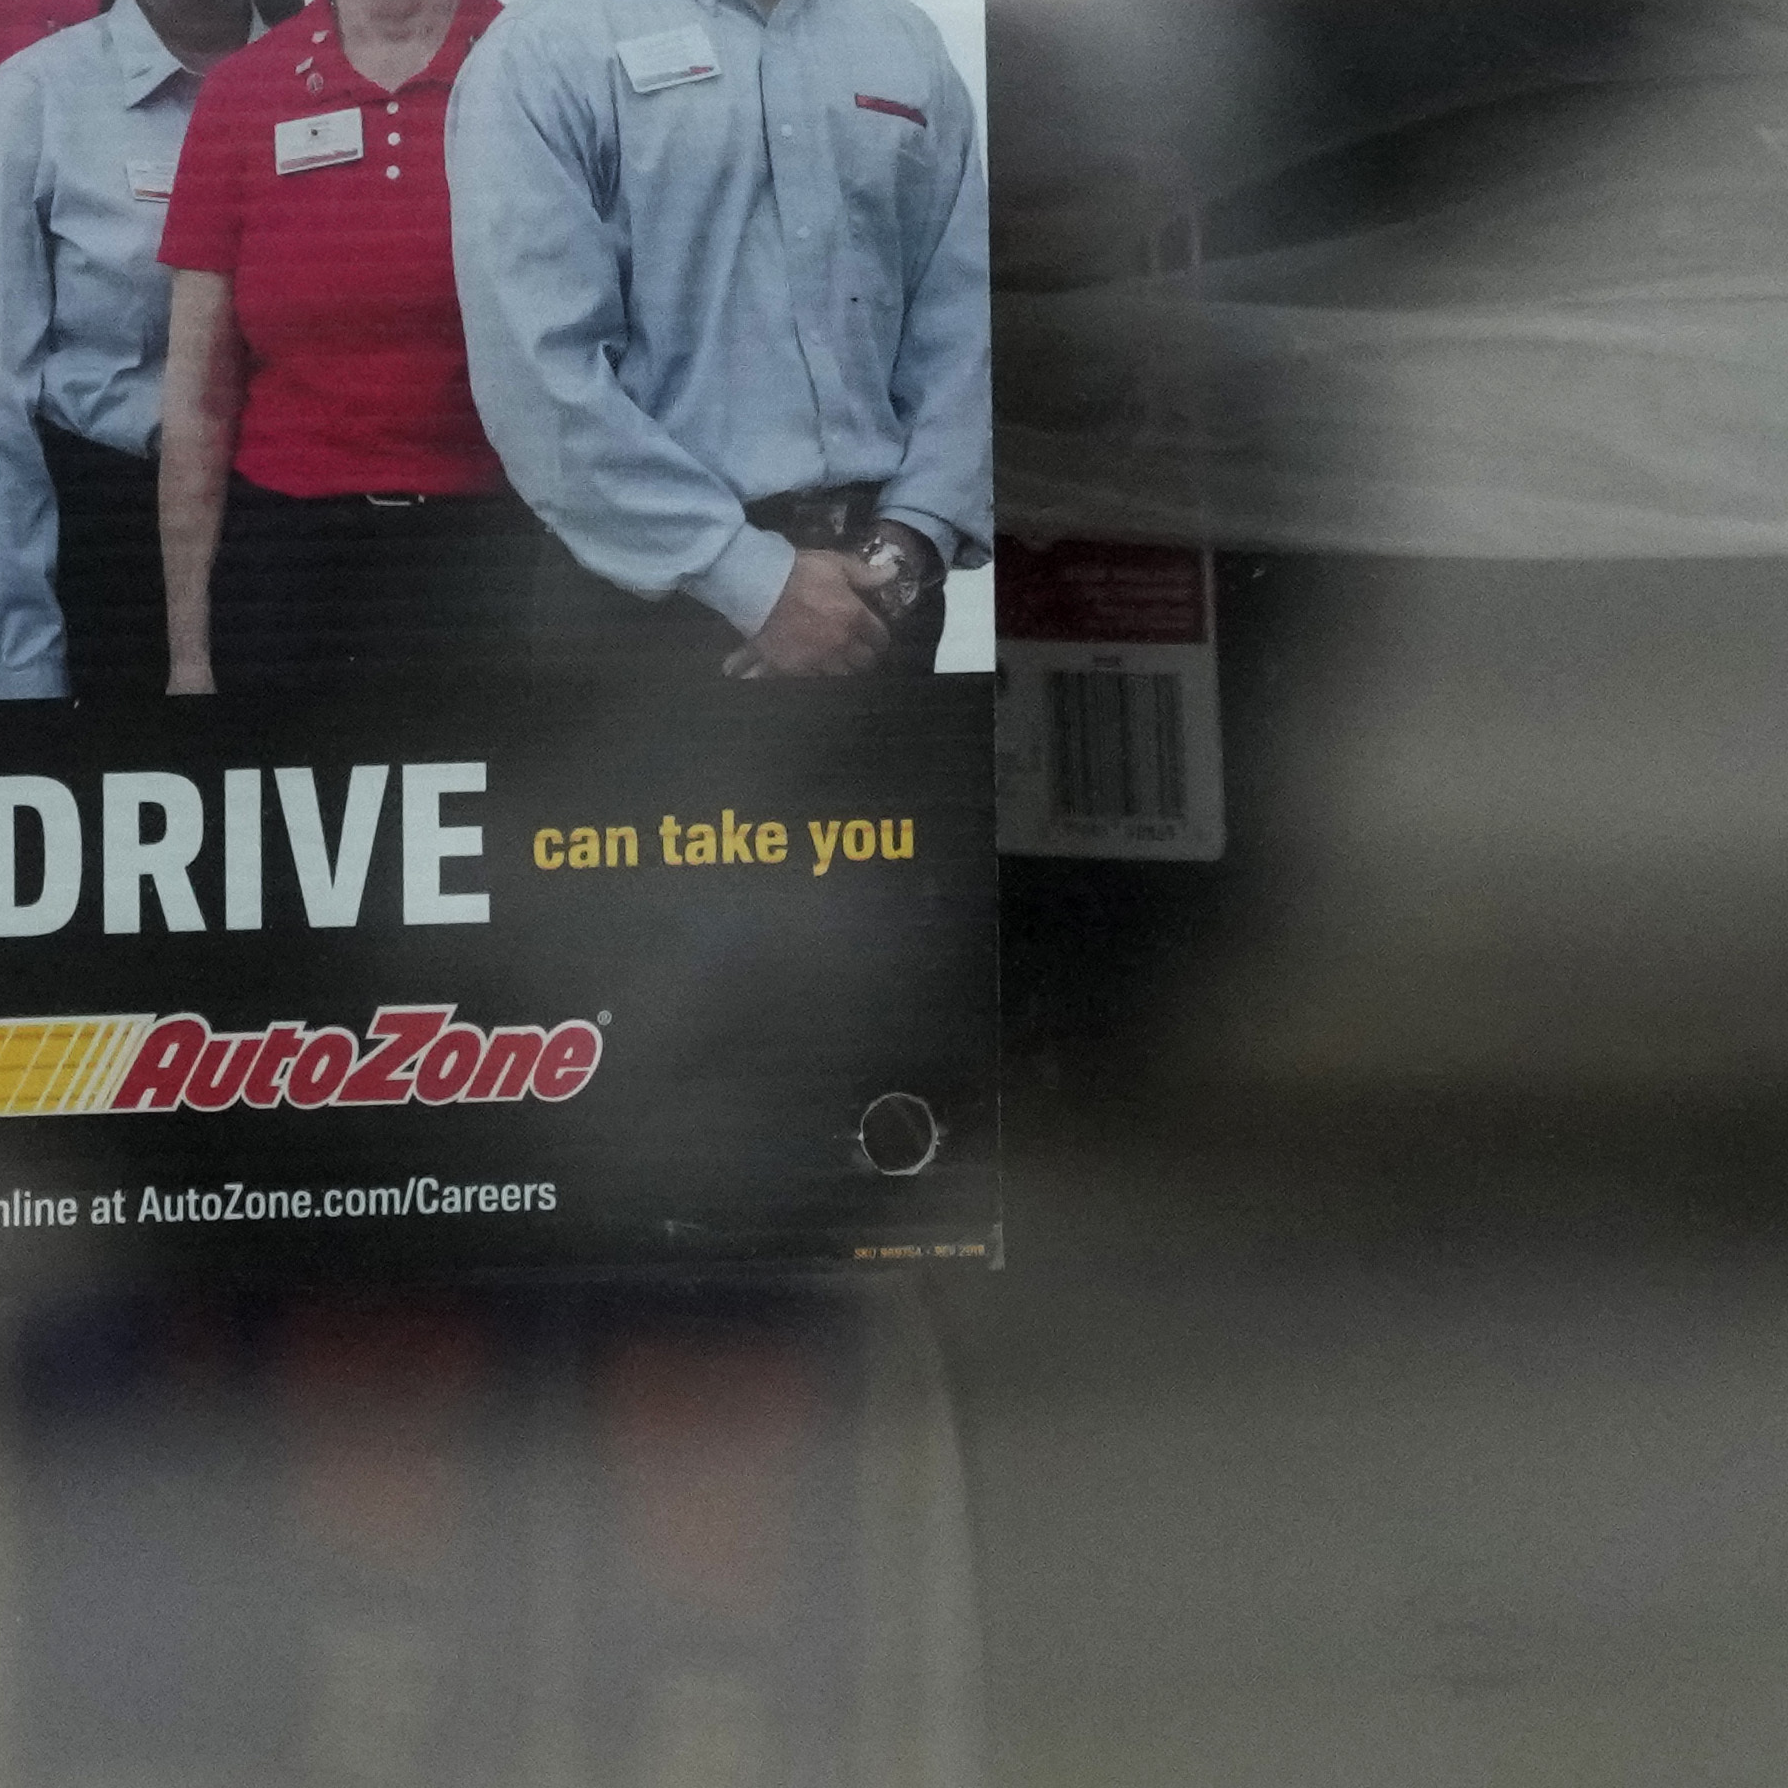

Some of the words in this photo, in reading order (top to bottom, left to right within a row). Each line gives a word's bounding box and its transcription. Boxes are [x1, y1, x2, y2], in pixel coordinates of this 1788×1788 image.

[533, 825, 639, 870] can
[660, 809, 789, 867] take
[808, 816, 916, 876] you
[109, 1003, 605, 1114] AutoZone
[90, 1192, 127, 1226] at
[137, 1176, 559, 1226] AutoZone.com/Careers
